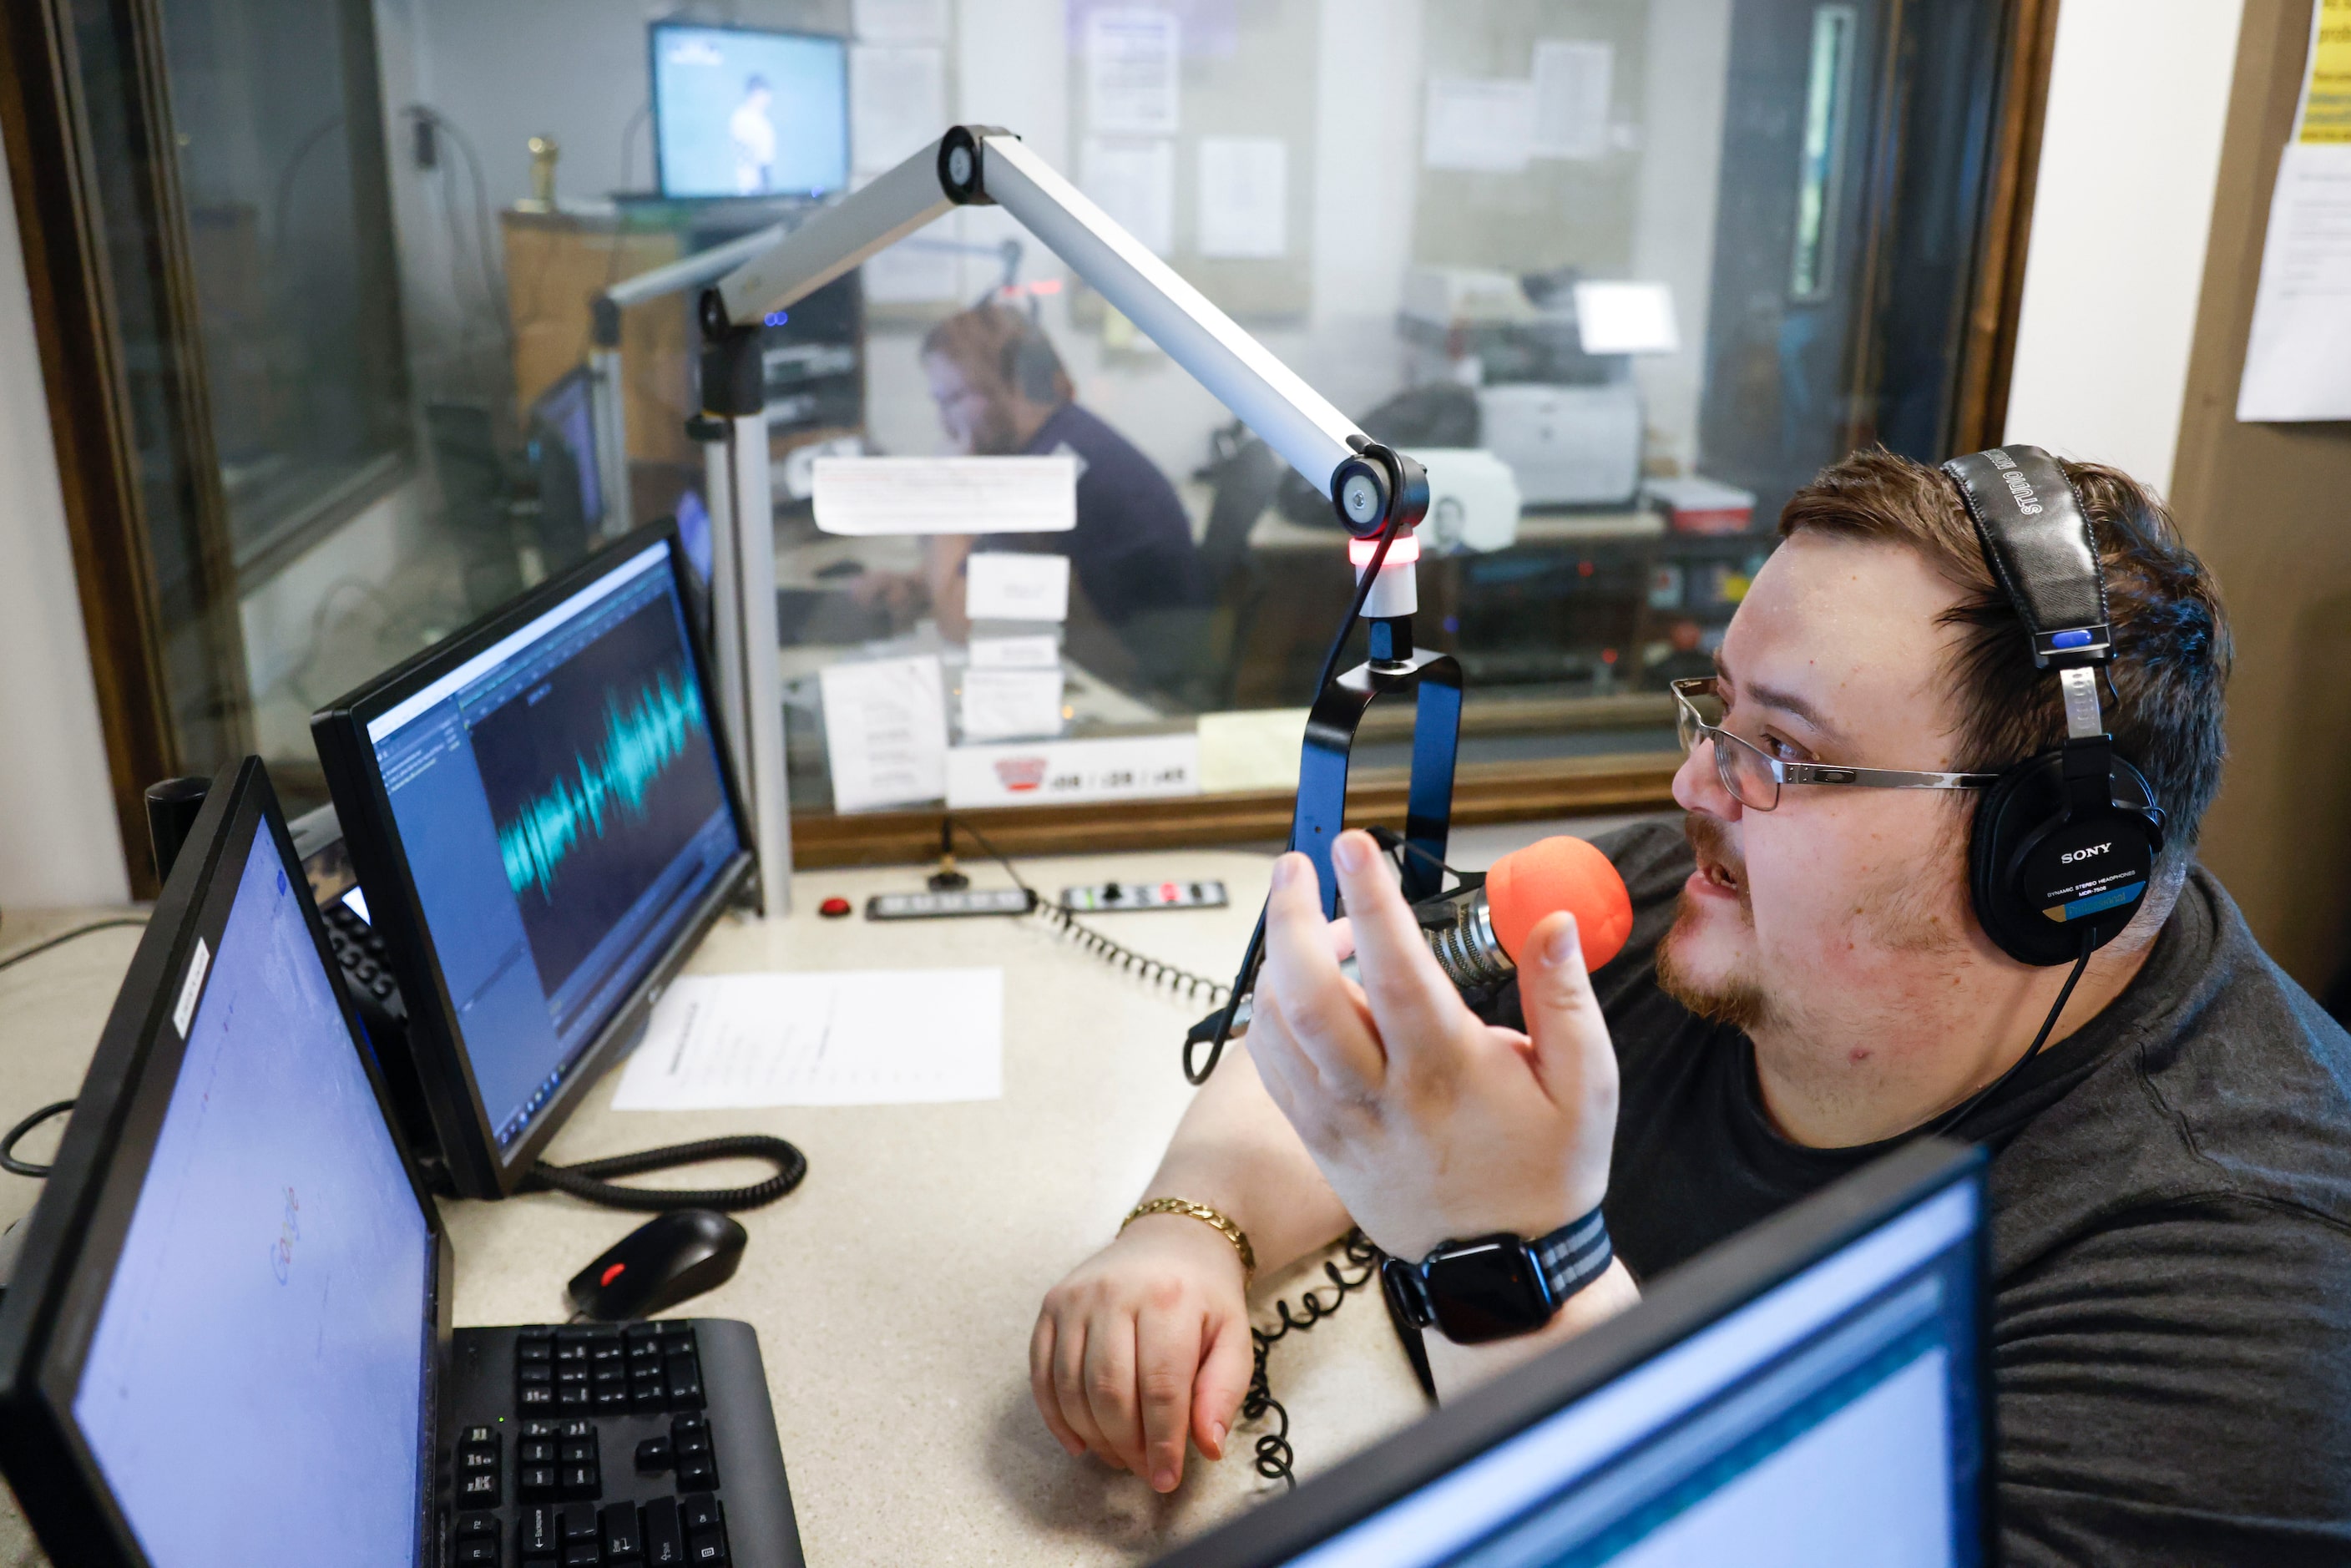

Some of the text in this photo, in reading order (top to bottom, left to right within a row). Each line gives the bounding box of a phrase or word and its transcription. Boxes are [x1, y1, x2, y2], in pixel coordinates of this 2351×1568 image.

[2003, 471, 2042, 515] STUDIO
[2061, 842, 2112, 864] SONY
[2047, 870, 2136, 898] DYNAMIC STEREO HEADPHONES
[270, 1186, 301, 1286] Google
